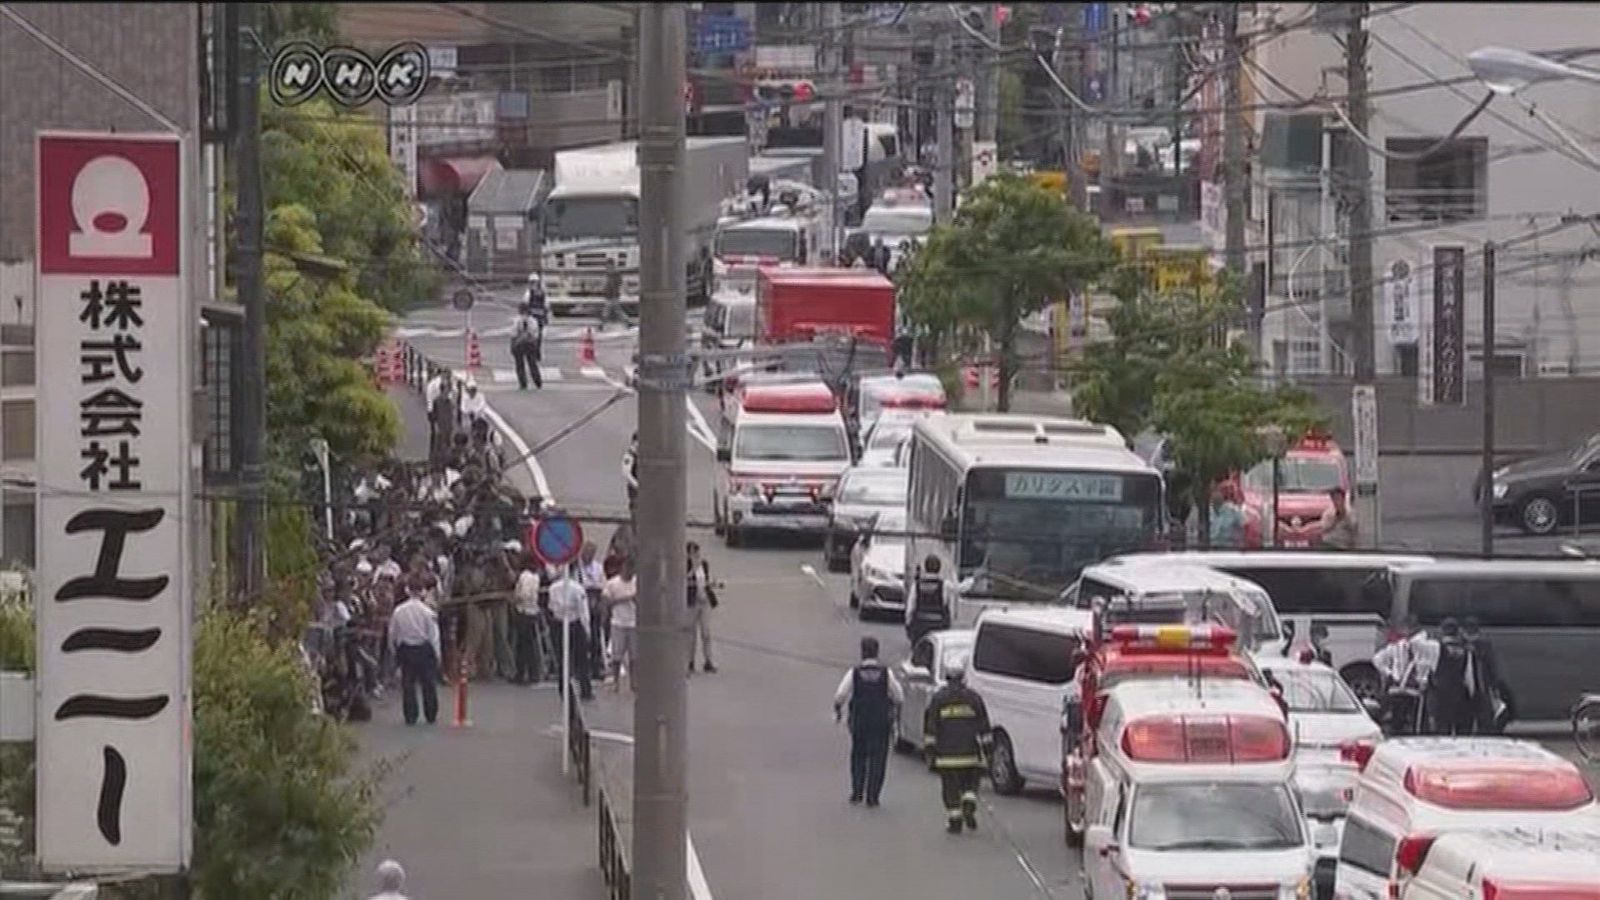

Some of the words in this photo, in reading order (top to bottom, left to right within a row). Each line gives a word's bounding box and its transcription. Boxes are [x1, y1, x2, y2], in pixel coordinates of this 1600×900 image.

[80, 281, 143, 490] 株式会社
[55, 508, 169, 845] エニー
